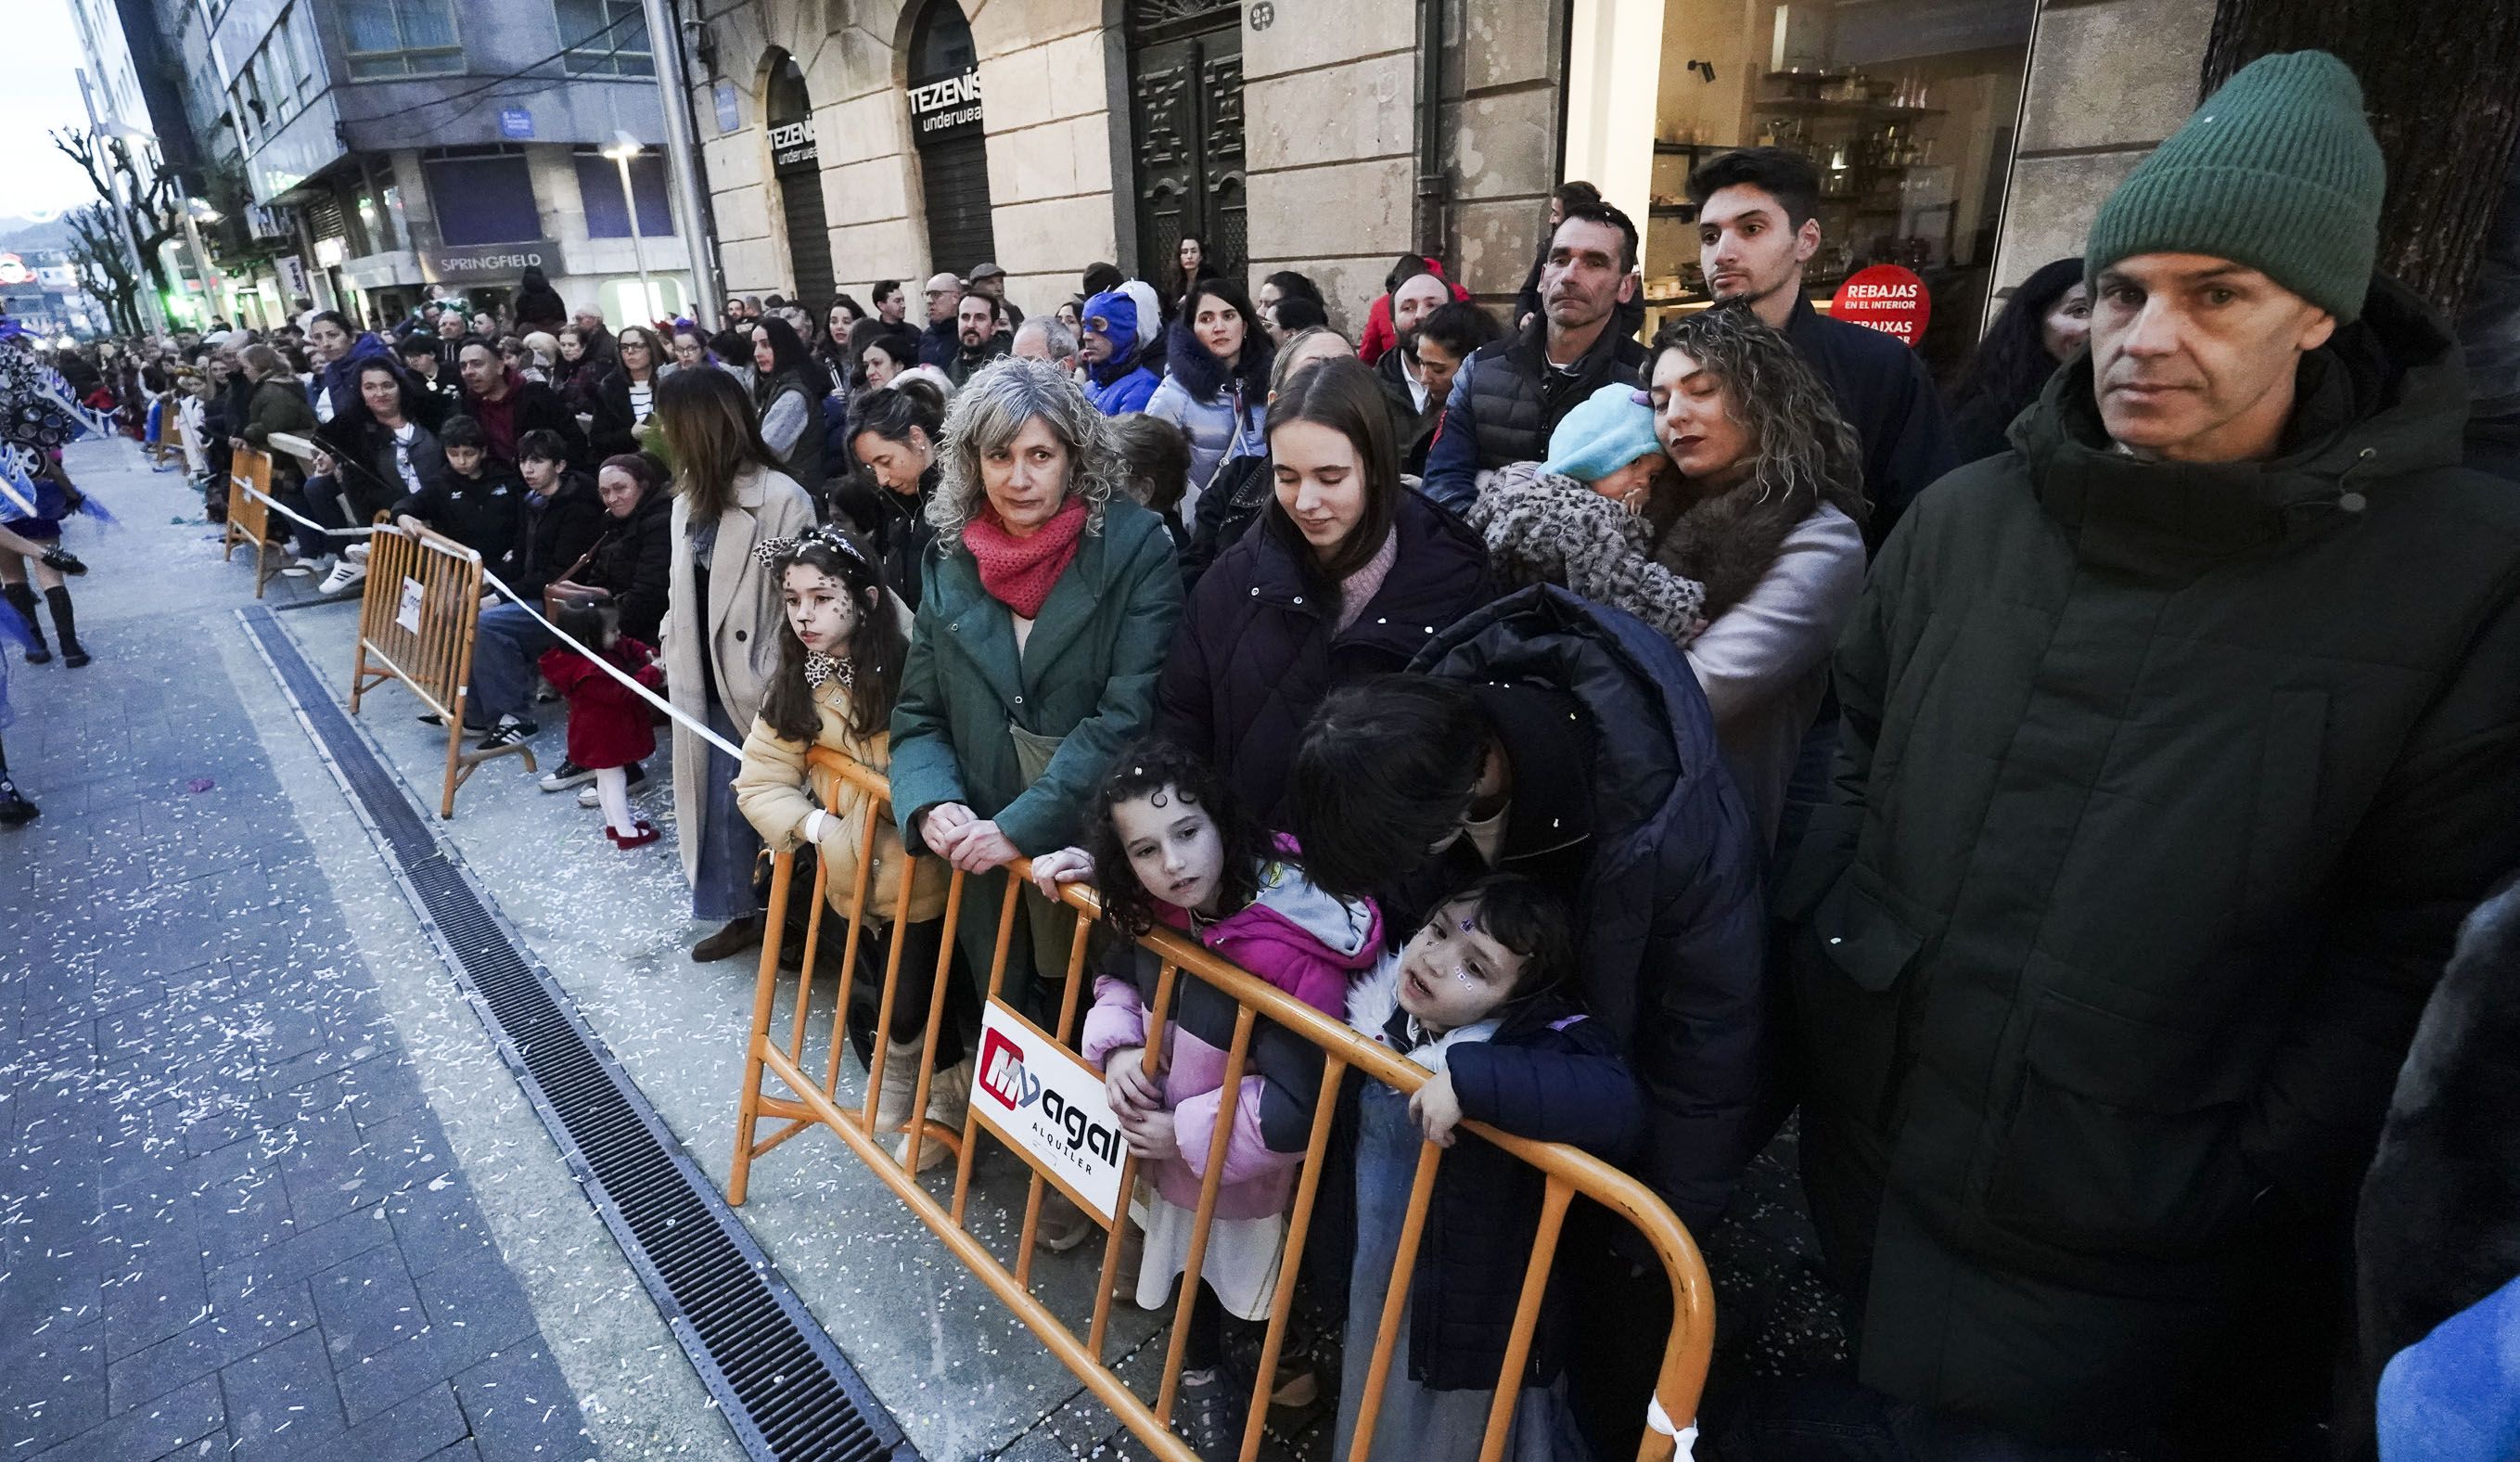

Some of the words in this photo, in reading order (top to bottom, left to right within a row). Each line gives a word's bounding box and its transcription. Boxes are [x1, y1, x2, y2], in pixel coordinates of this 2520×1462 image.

[923, 106, 983, 132] underwea
[441, 252, 542, 272] SPRINGFIELD
[1848, 284, 1918, 298] REBAJAS
[1845, 301, 1858, 310] EN
[1859, 301, 1870, 310] EL
[1871, 301, 1916, 310] INTERIOR
[1032, 1122, 1093, 1175] ALQUILER
